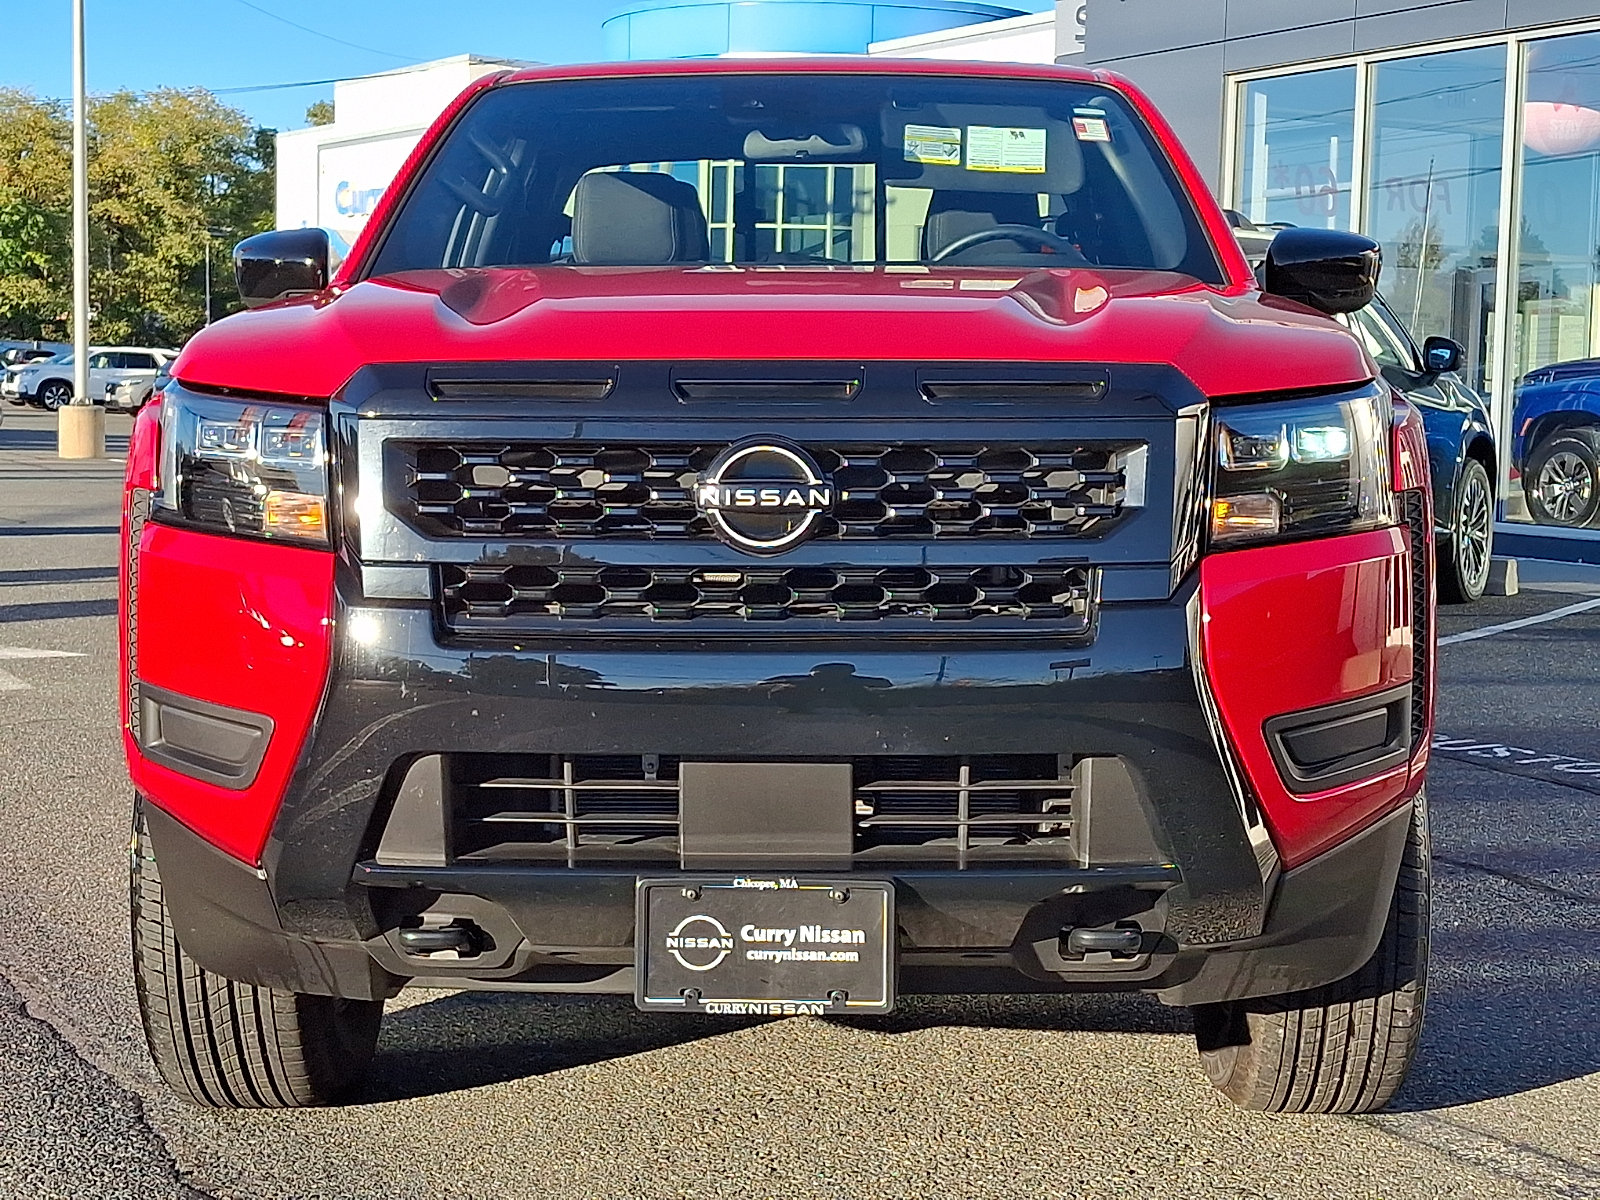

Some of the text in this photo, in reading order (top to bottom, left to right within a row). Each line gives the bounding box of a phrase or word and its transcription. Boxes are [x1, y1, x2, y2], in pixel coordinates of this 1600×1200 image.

[699, 485, 831, 507] NISSAN
[779, 877, 799, 889] MA
[666, 937, 734, 949] NISSAN
[740, 924, 866, 946] Curry Nissan
[746, 947, 859, 963] currynissan.com
